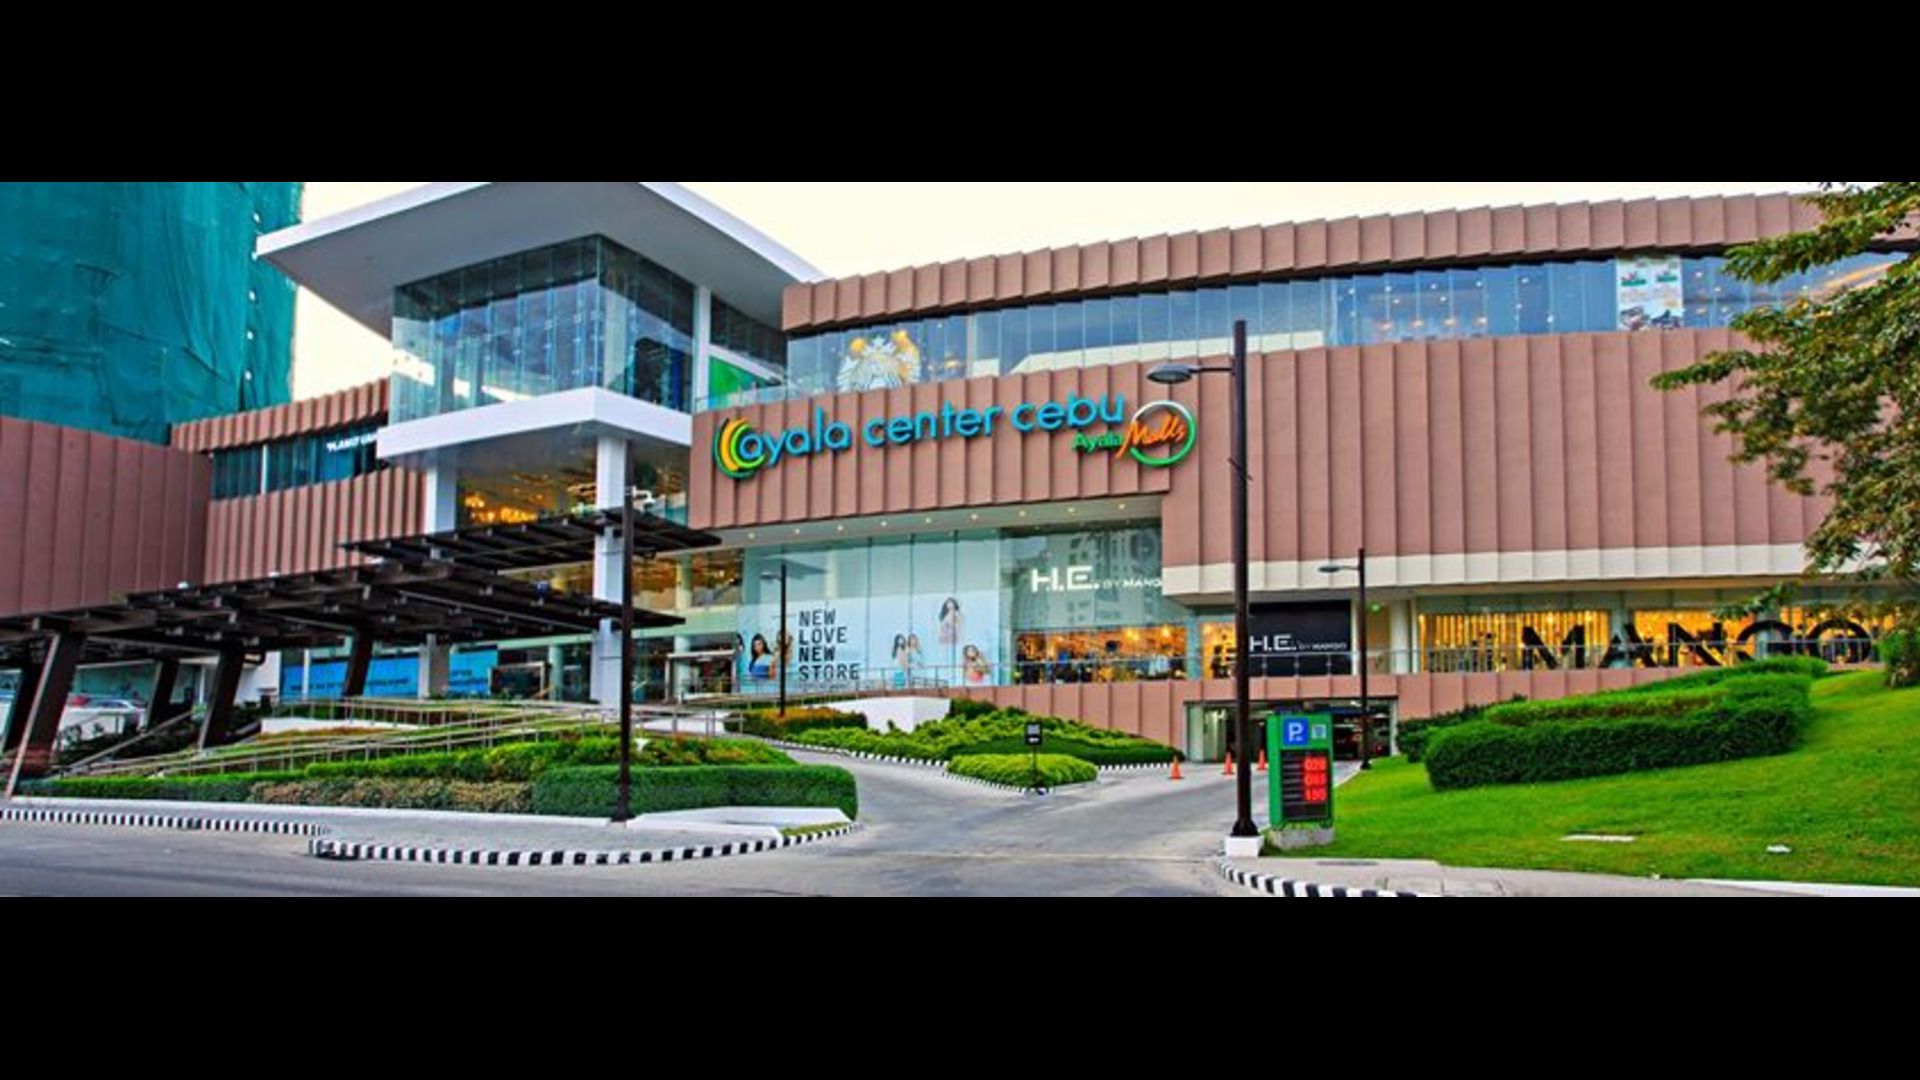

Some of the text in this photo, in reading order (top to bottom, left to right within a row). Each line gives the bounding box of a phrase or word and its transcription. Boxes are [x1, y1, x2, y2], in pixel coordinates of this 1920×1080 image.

[738, 390, 1124, 467] ayala center cebu
[1115, 412, 1187, 459] Malls
[1071, 431, 1123, 453] Ayala
[1031, 565, 1099, 593] H.E.
[798, 609, 836, 627] NEW
[798, 626, 847, 645] LOVE
[798, 645, 836, 663] NEW
[798, 663, 861, 681] STORE
[1288, 722, 1304, 742] P
